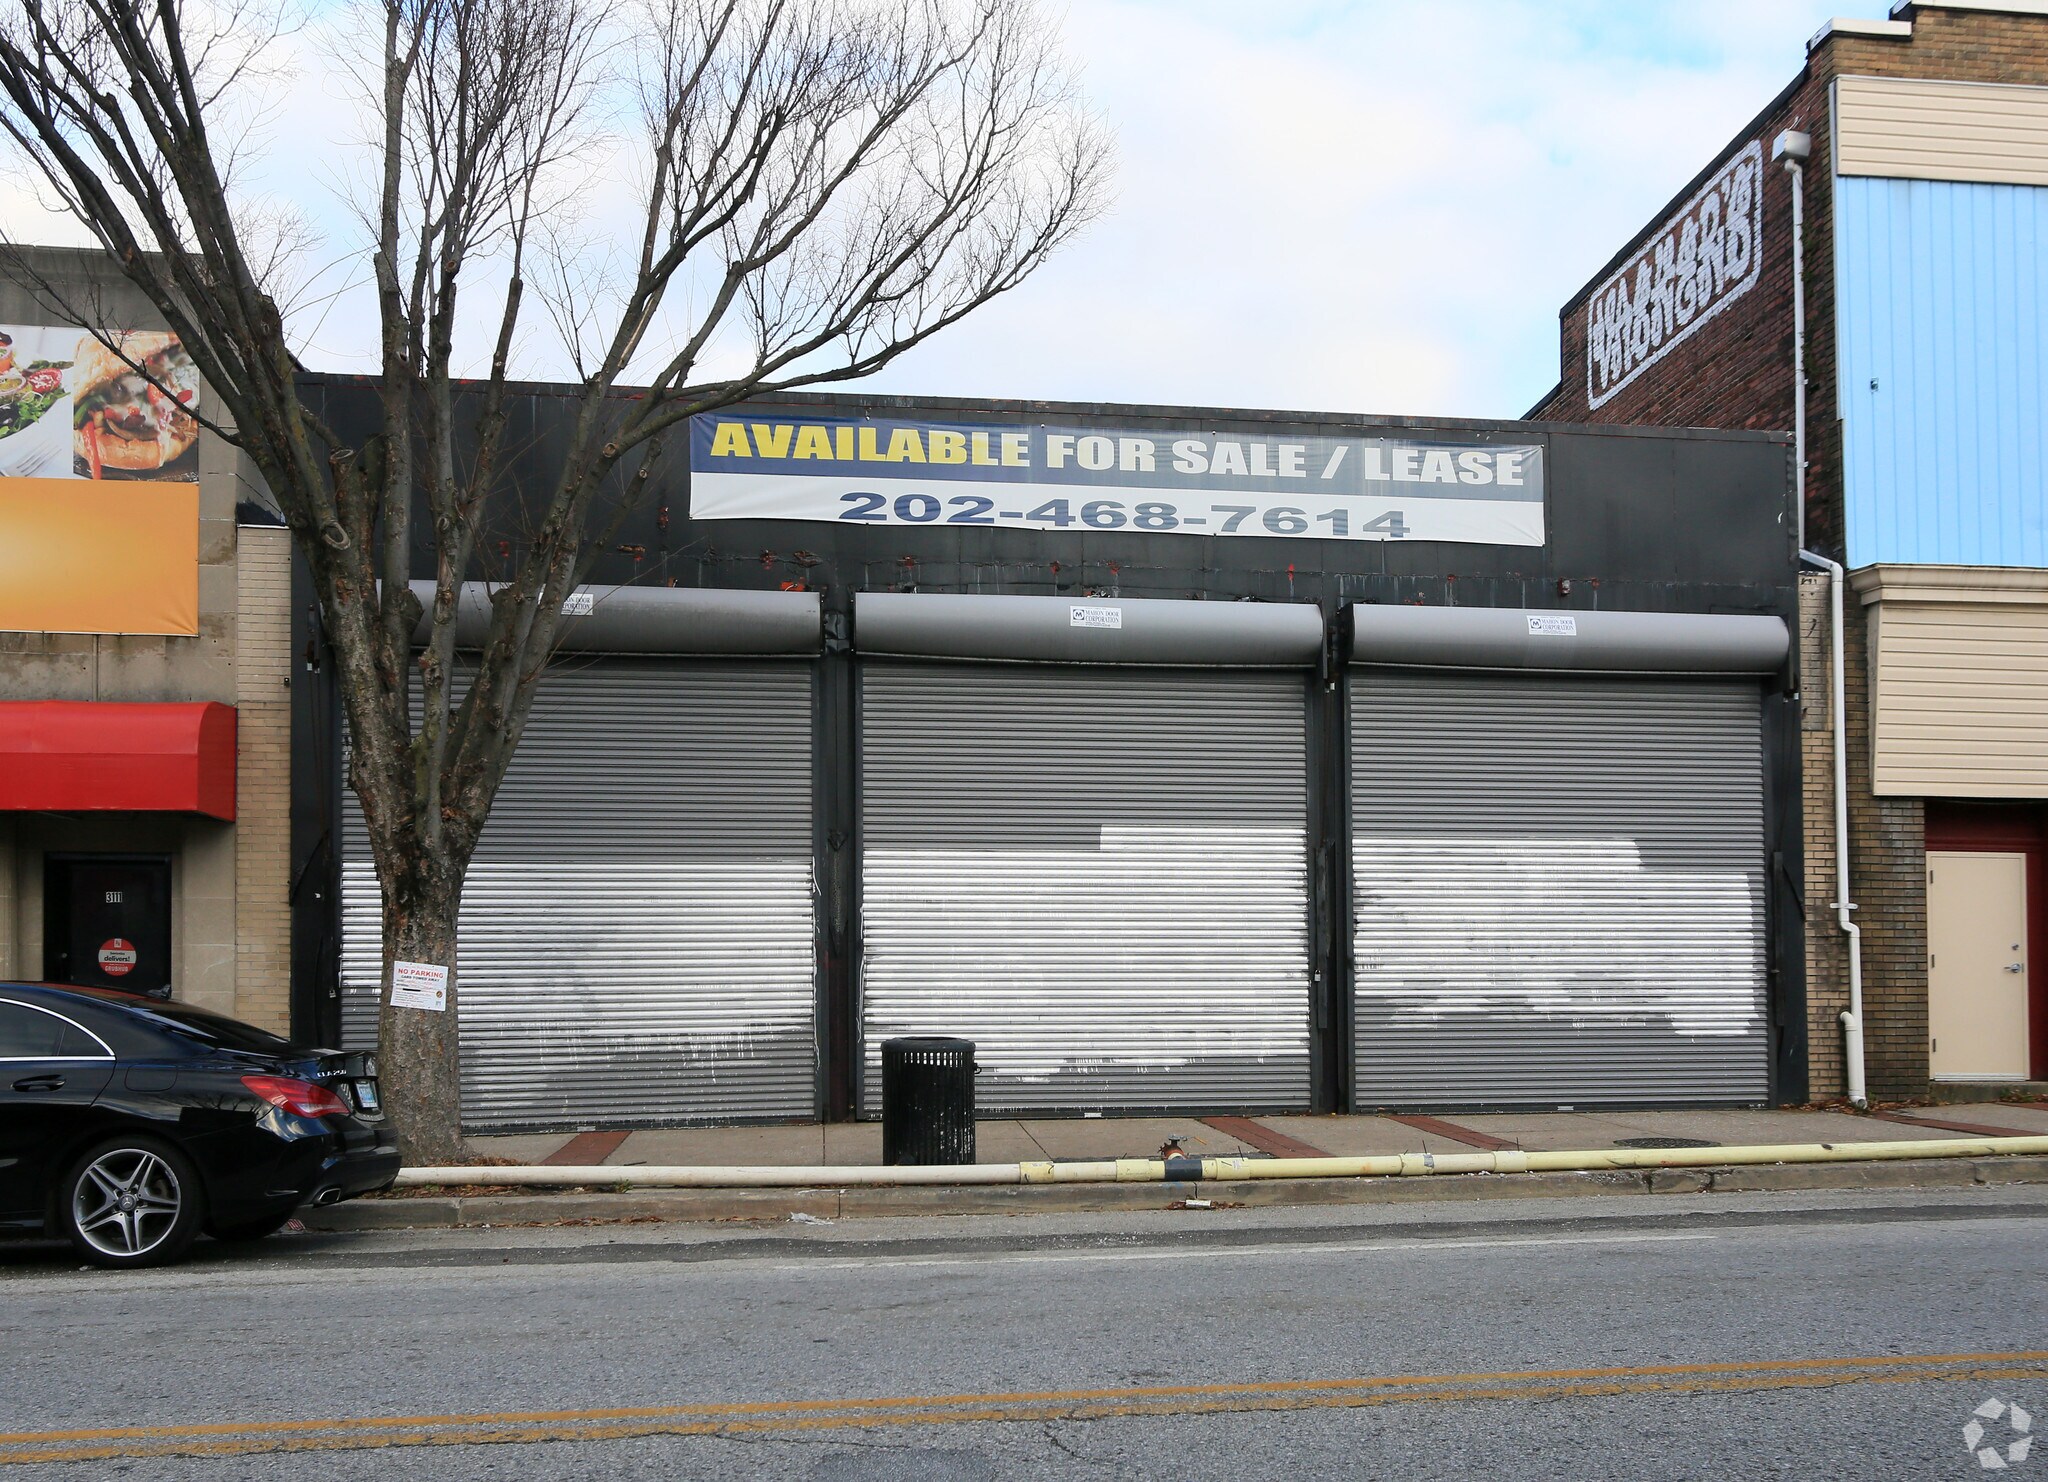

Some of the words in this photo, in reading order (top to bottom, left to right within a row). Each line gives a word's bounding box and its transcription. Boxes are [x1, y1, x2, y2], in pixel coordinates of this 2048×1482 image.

[710, 422, 1031, 467] AVAILABLE
[1046, 434, 1156, 472] FOR
[1172, 438, 1307, 478] SALE
[1364, 447, 1524, 486] LEASE
[838, 491, 1411, 538] 202-468-7614
[106, 892, 123, 903] 3111
[411, 970, 443, 978] PARKING
